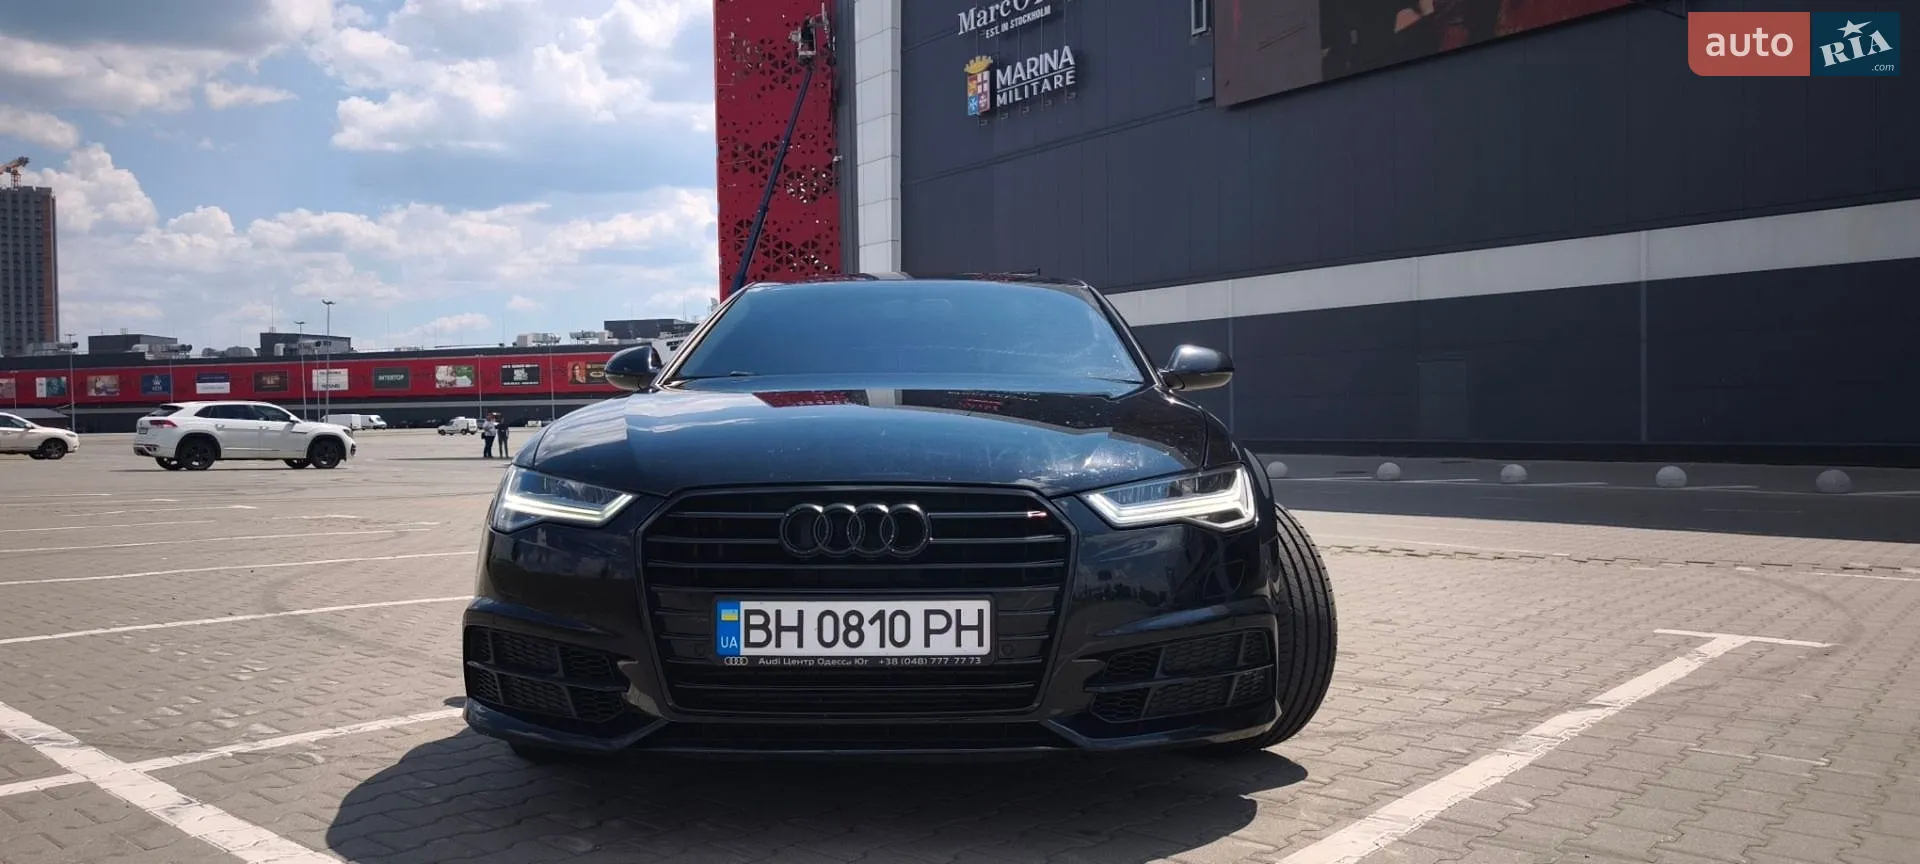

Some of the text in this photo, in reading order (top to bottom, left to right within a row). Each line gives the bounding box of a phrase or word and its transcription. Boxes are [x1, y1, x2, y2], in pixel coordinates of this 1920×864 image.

[1009, 5, 1052, 29] STOCKHOLM
[996, 45, 1076, 90] MARINA
[996, 70, 1076, 108] MILITARE
[720, 635, 738, 649] UA
[816, 608, 911, 649] 0810
[758, 657, 781, 665] Audi
[783, 657, 815, 667] Центр
[879, 657, 898, 665] +38
[900, 656, 928, 666] (048)
[929, 656, 949, 665] 777
